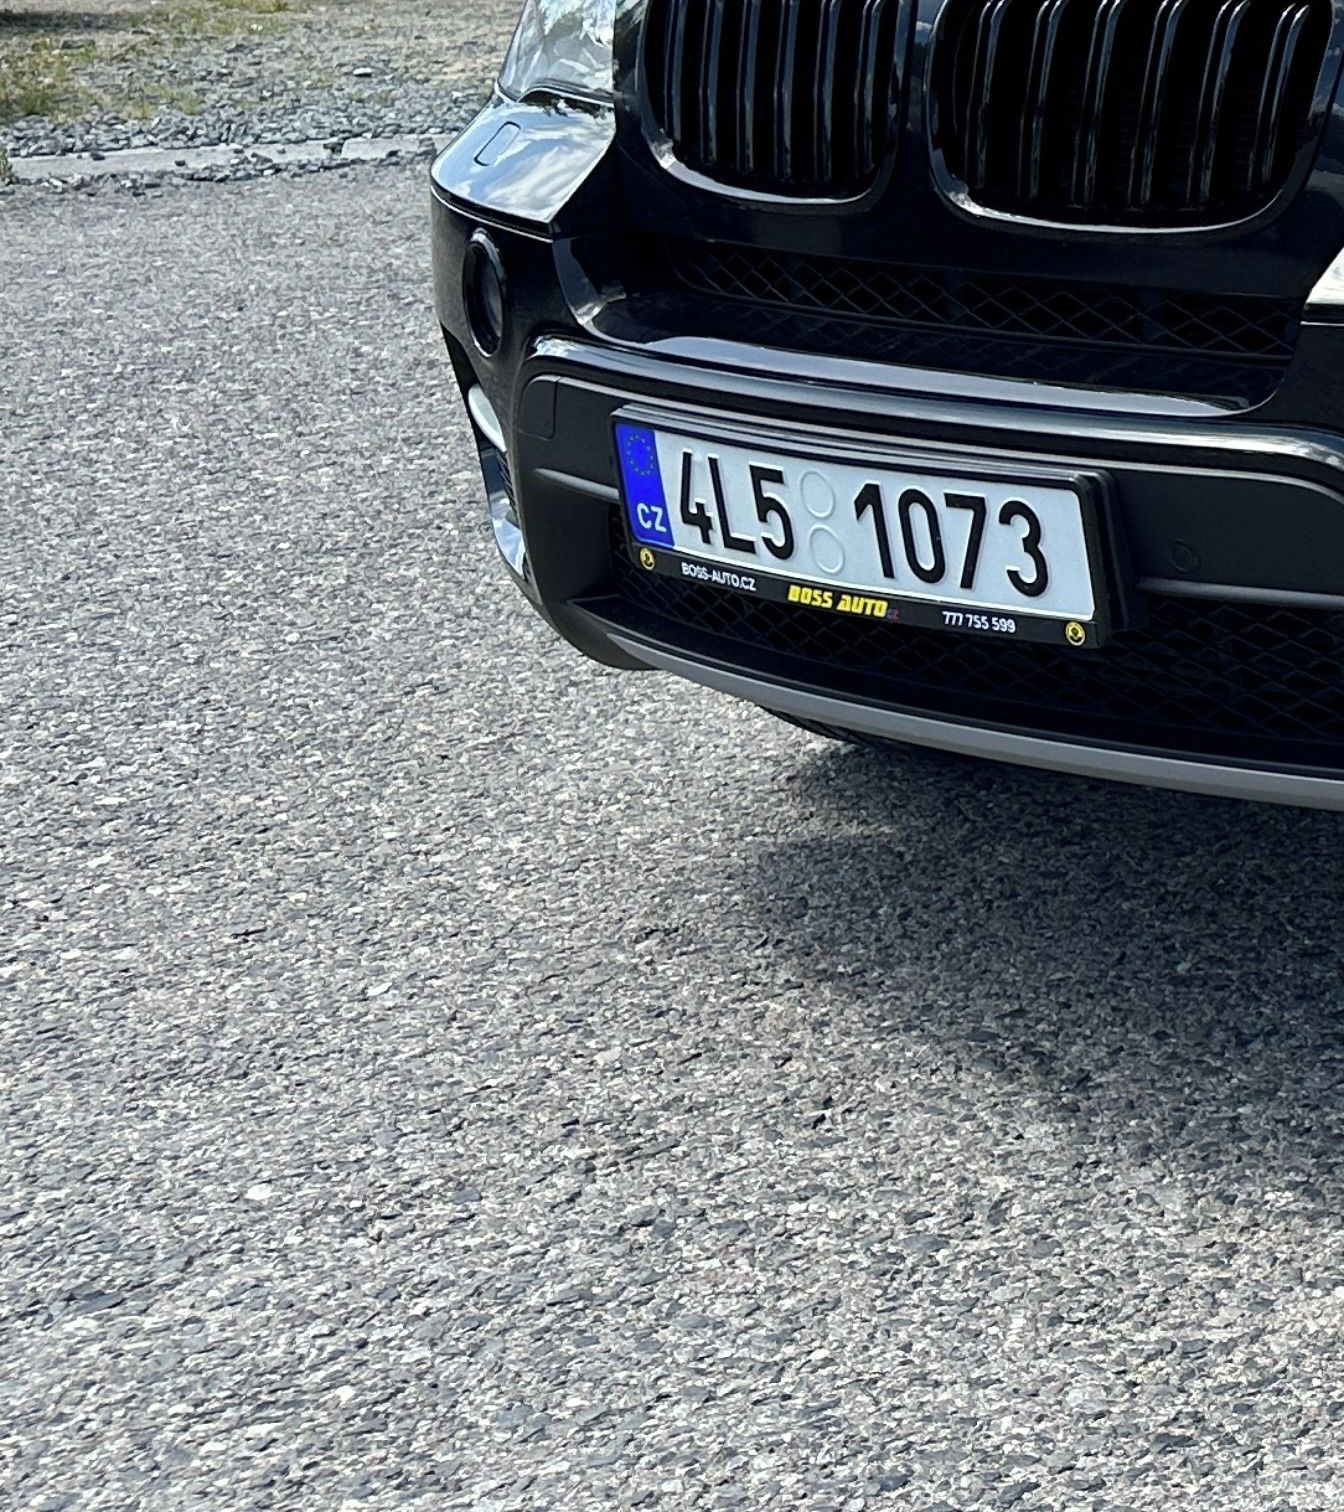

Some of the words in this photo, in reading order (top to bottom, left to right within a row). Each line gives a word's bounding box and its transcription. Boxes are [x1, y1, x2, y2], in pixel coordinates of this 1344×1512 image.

[636, 500, 668, 534] CZ
[679, 450, 796, 561] 4L5
[853, 481, 1049, 598] 1073
[681, 561, 757, 592] BOSS-AUTO.CZ
[787, 584, 834, 611] BOSS
[836, 595, 889, 619] AUTO
[942, 610, 966, 627] 777
[965, 613, 990, 630] 755
[990, 617, 1016, 634] 599
